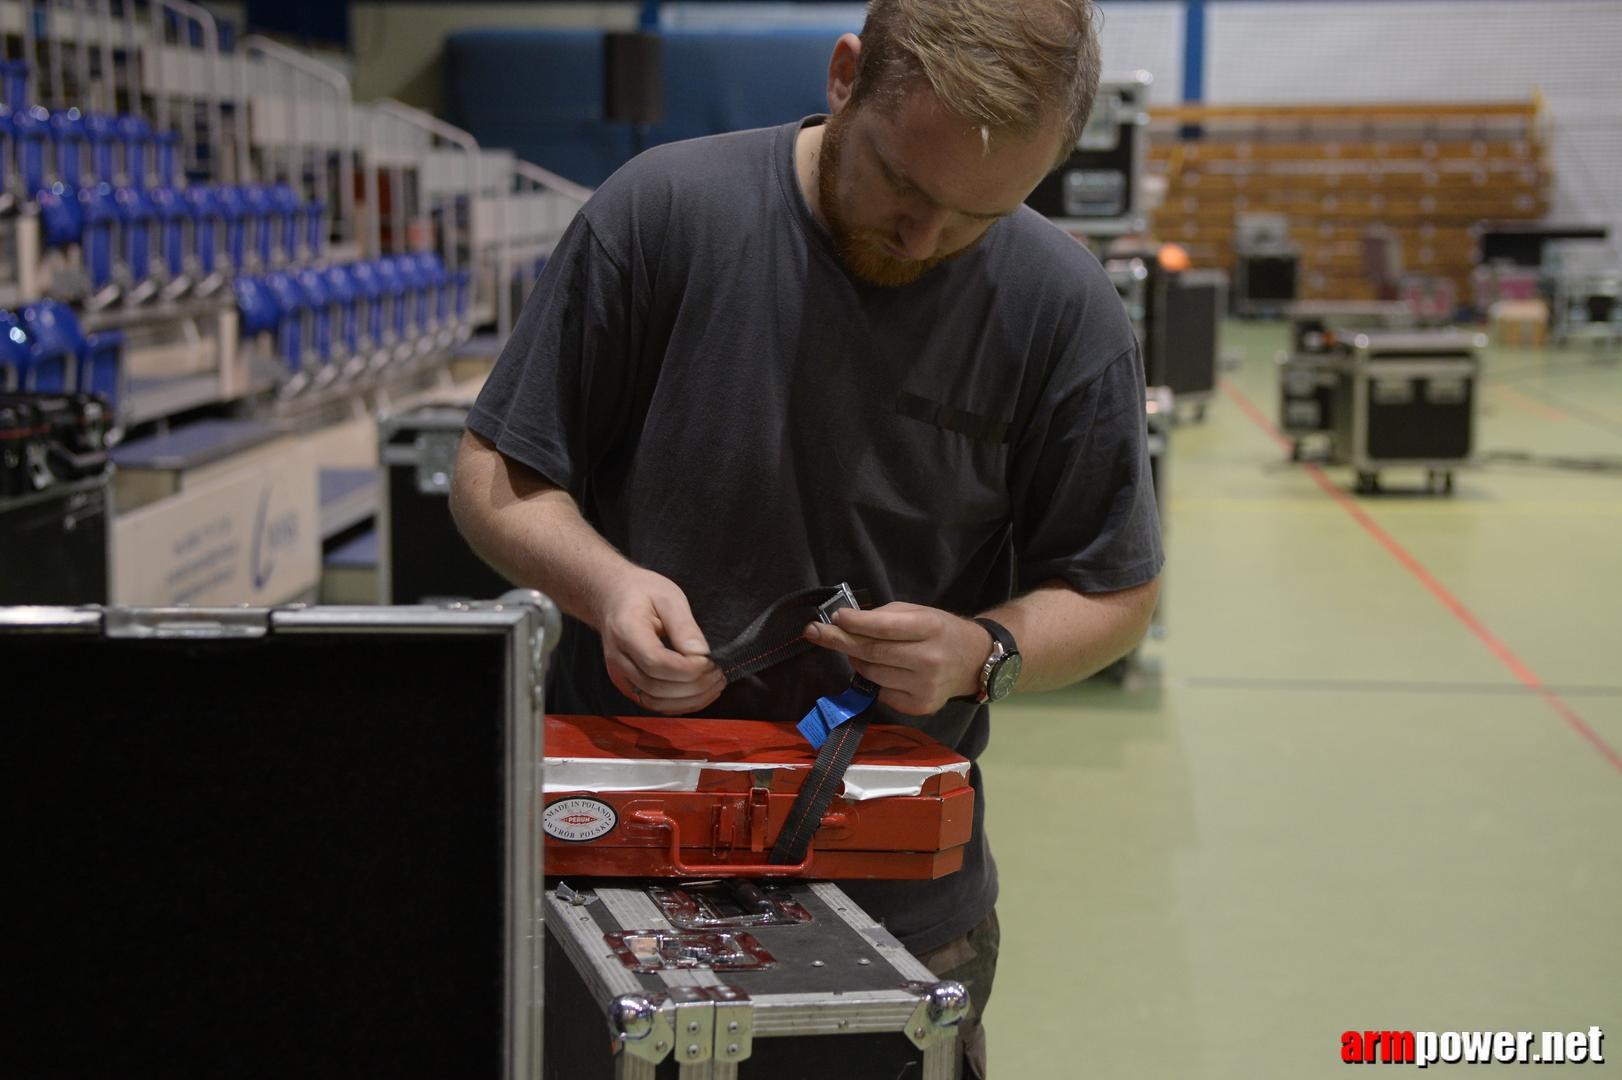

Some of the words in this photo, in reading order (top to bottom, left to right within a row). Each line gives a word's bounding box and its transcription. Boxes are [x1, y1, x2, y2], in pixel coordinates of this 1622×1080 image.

[546, 801, 569, 818] MADE
[571, 800, 580, 808] IN
[581, 800, 611, 819] POLAND
[580, 821, 611, 839] POLSKI
